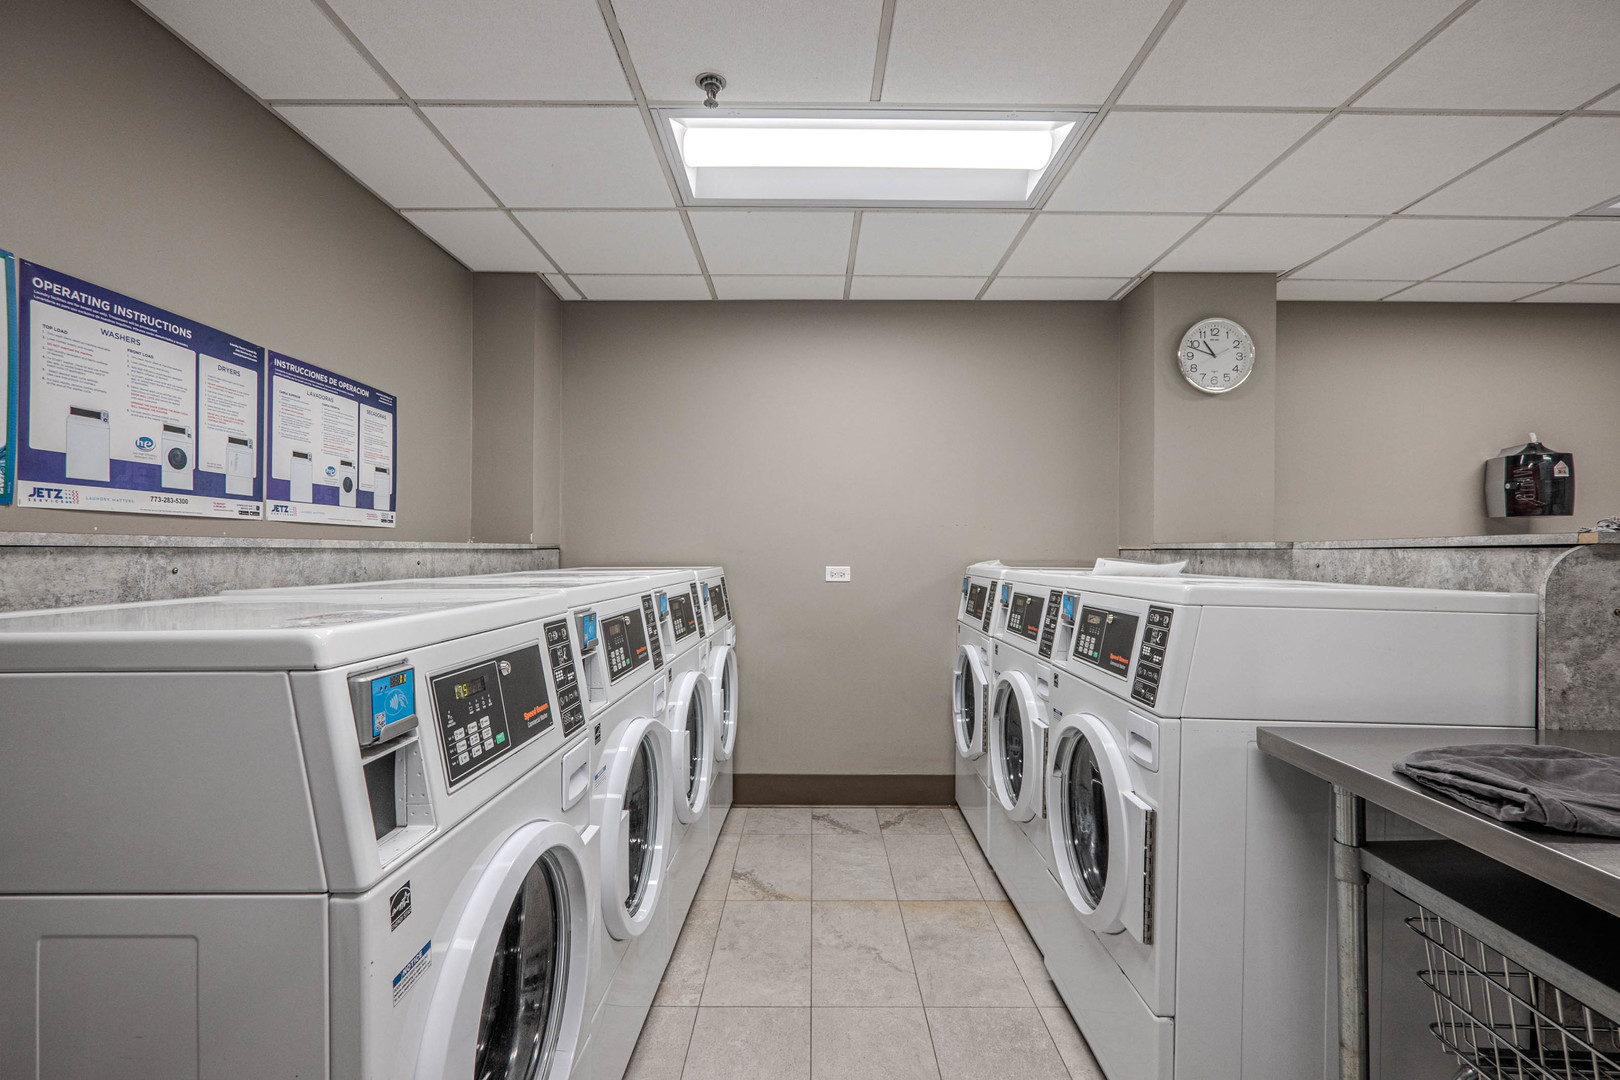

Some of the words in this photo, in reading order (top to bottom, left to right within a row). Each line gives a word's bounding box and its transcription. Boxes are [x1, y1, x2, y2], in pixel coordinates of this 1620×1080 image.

[32, 277, 110, 311] OPERATING
[114, 304, 192, 339] INSTRUCTIONS
[1210, 328, 1219, 336] 12
[101, 328, 141, 346] WASHERS
[1190, 340, 1200, 349] 10
[1233, 340, 1240, 348] 2
[127, 348, 141, 356] FRONT
[1186, 352, 1194, 360] 9
[1236, 352, 1243, 360] 3
[218, 365, 240, 377] DRYERS
[1190, 364, 1197, 372] 8
[274, 358, 328, 382] INSTRUCCIONES
[329, 378, 338, 386] DE
[338, 381, 370, 397] OPERACION
[1210, 376, 1218, 385] 6
[1224, 373, 1230, 382] 5
[306, 390, 334, 402] LAVADORAS
[366, 410, 387, 420] SECADORAS
[28, 487, 63, 499] JETZ
[150, 496, 189, 505] 773-283-5300
[524, 706, 536, 720] Speed
[536, 703, 548, 713] Queen
[528, 716, 541, 728] Commercial
[401, 950, 423, 979] NOTICE
